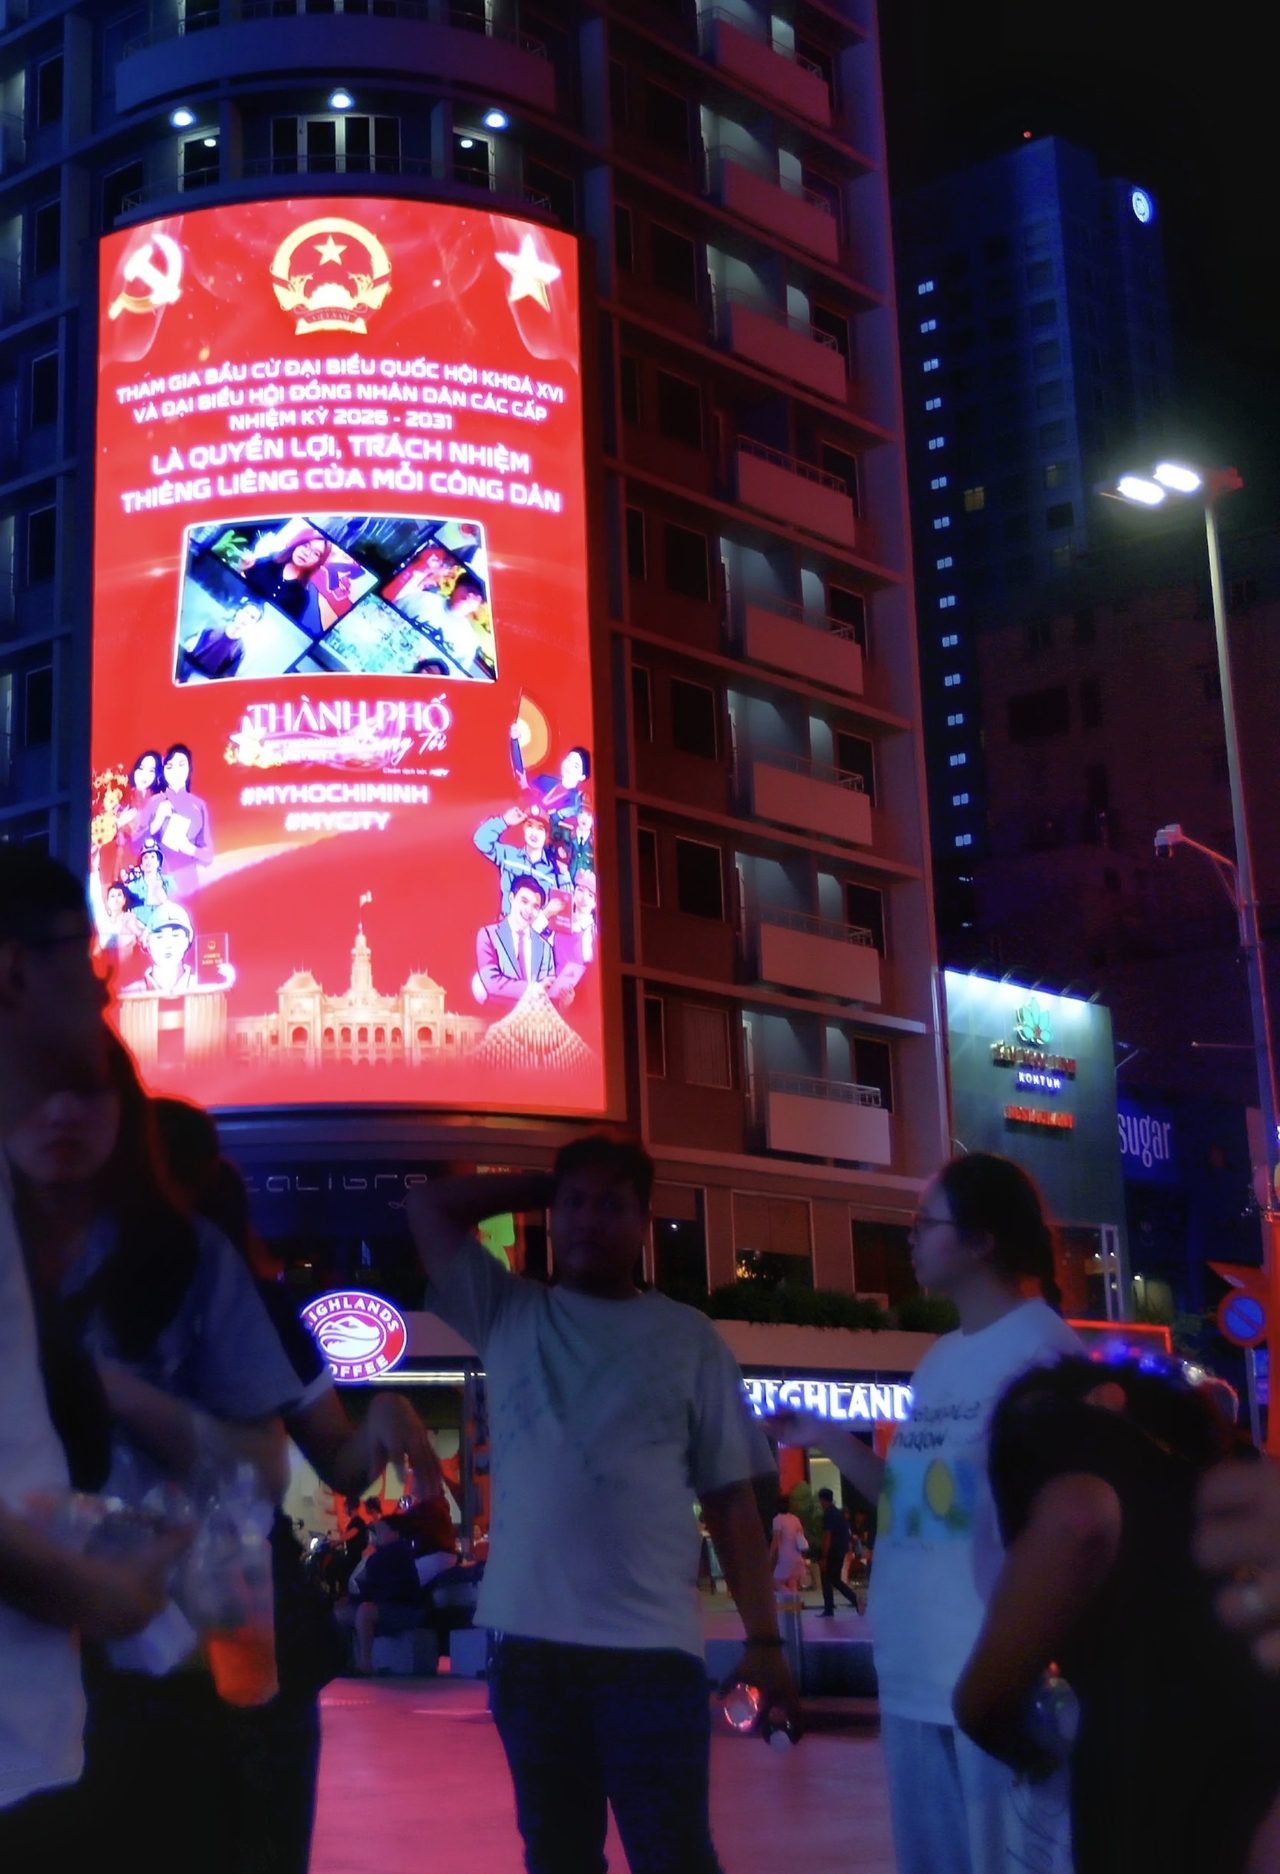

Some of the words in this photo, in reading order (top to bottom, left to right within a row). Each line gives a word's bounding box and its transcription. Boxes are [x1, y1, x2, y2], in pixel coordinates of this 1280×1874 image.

[116, 378, 165, 404] THAM
[168, 371, 201, 392] GIA
[285, 359, 321, 379] ĐẠI
[379, 356, 440, 379] QUỐC
[444, 364, 478, 386] HỘI
[536, 382, 565, 404] XVI
[133, 401, 159, 424] VÀ
[161, 397, 195, 418] ĐẠI
[248, 382, 285, 407] HỘI
[357, 382, 419, 402] NHÂN
[422, 387, 467, 408] DÂN
[469, 392, 509, 414] CÁC
[229, 407, 297, 432] NHIỆM
[300, 406, 329, 427] KỲ
[332, 409, 389, 427] 2026
[405, 411, 453, 430] 2031
[151, 446, 184, 475] LÀ
[348, 434, 443, 462] TRÁCH
[449, 441, 531, 475] NHIỆM
[121, 477, 212, 513] THIÊNG
[217, 467, 299, 497] LIÊNG
[305, 463, 367, 491] CỦA
[429, 471, 504, 501] CÔNG
[509, 482, 562, 513] DÂN
[246, 694, 367, 731] THÀNH
[375, 693, 451, 732] PHỐ
[241, 783, 430, 806] #MYHOCHIMINH
[284, 811, 391, 832] #MYCITY
[1117, 1113, 1171, 1168] sugar
[308, 1296, 400, 1332] IGHLANDS
[329, 1354, 389, 1378] OFFEE
[745, 1380, 914, 1419] HIGHLAND
